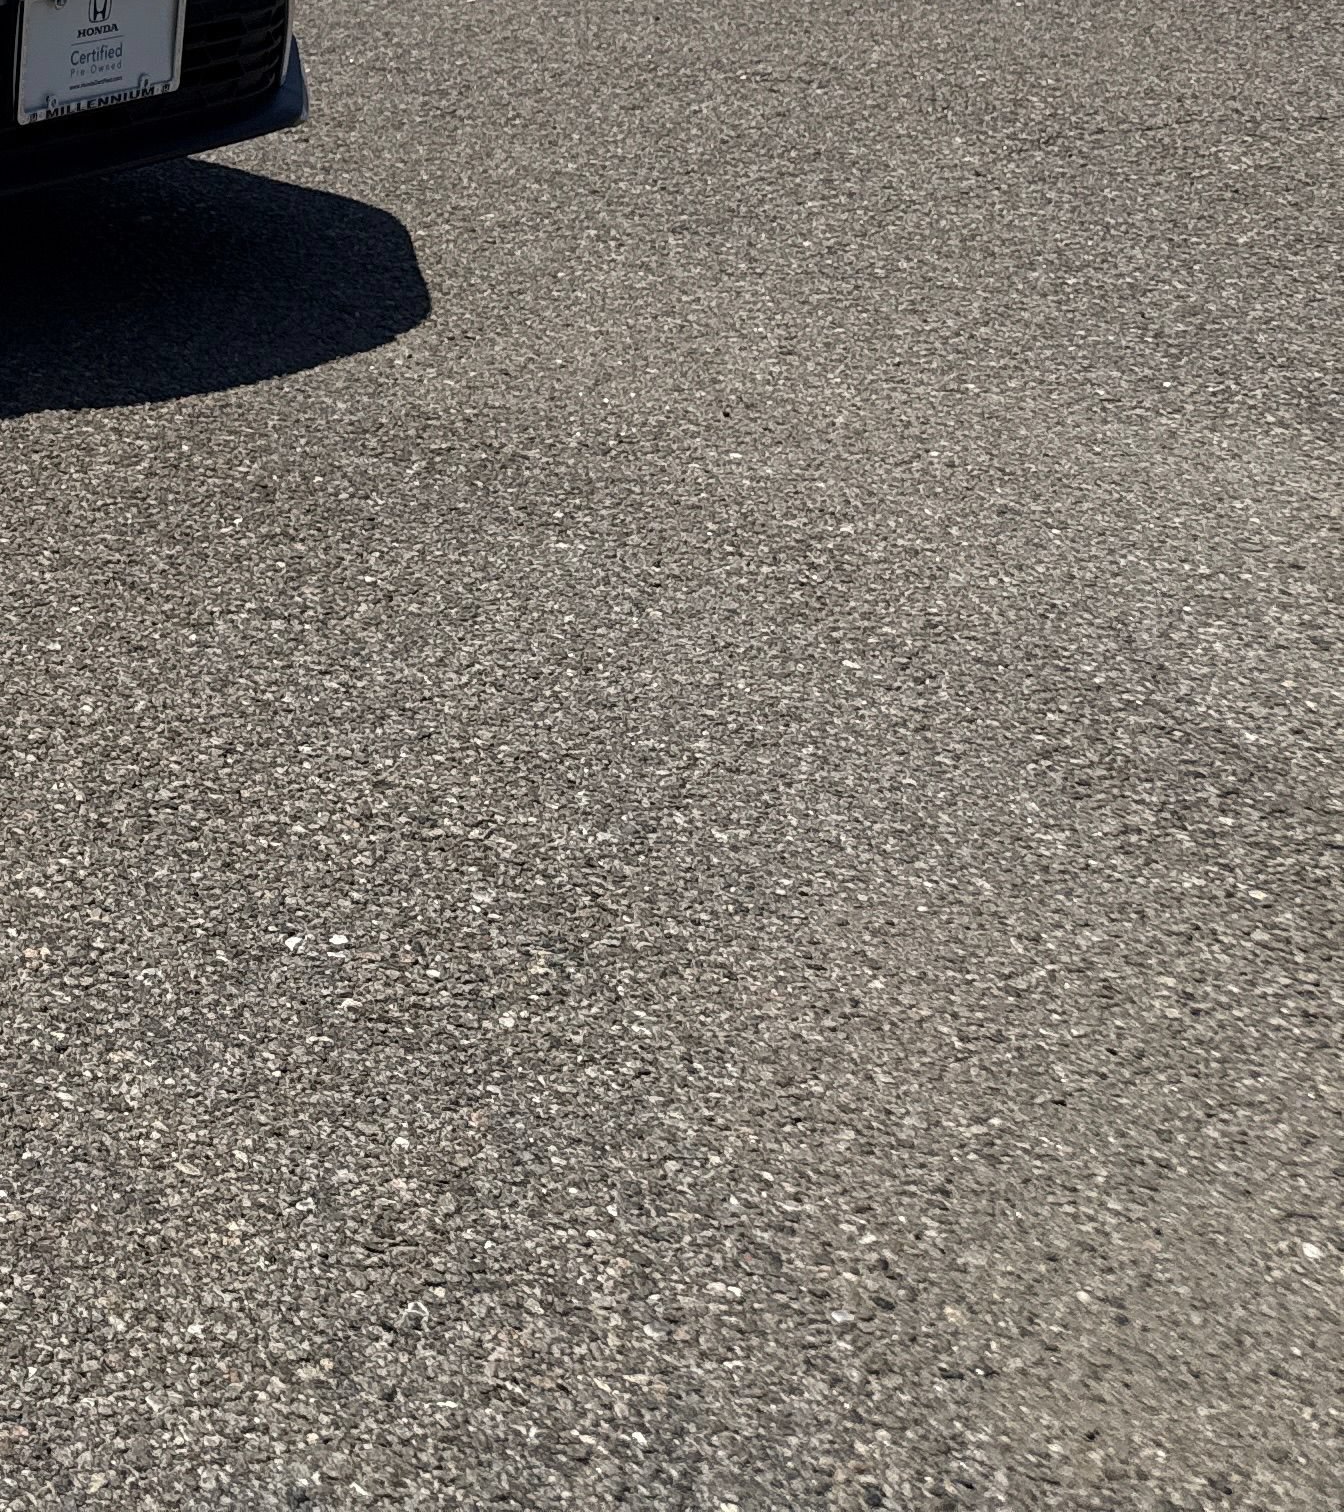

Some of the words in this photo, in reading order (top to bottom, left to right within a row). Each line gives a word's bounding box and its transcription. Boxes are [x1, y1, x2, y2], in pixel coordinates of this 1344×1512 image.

[77, 23, 119, 38] HONDA
[71, 42, 123, 66] Certified
[46, 86, 155, 119] MILLENNIUM
